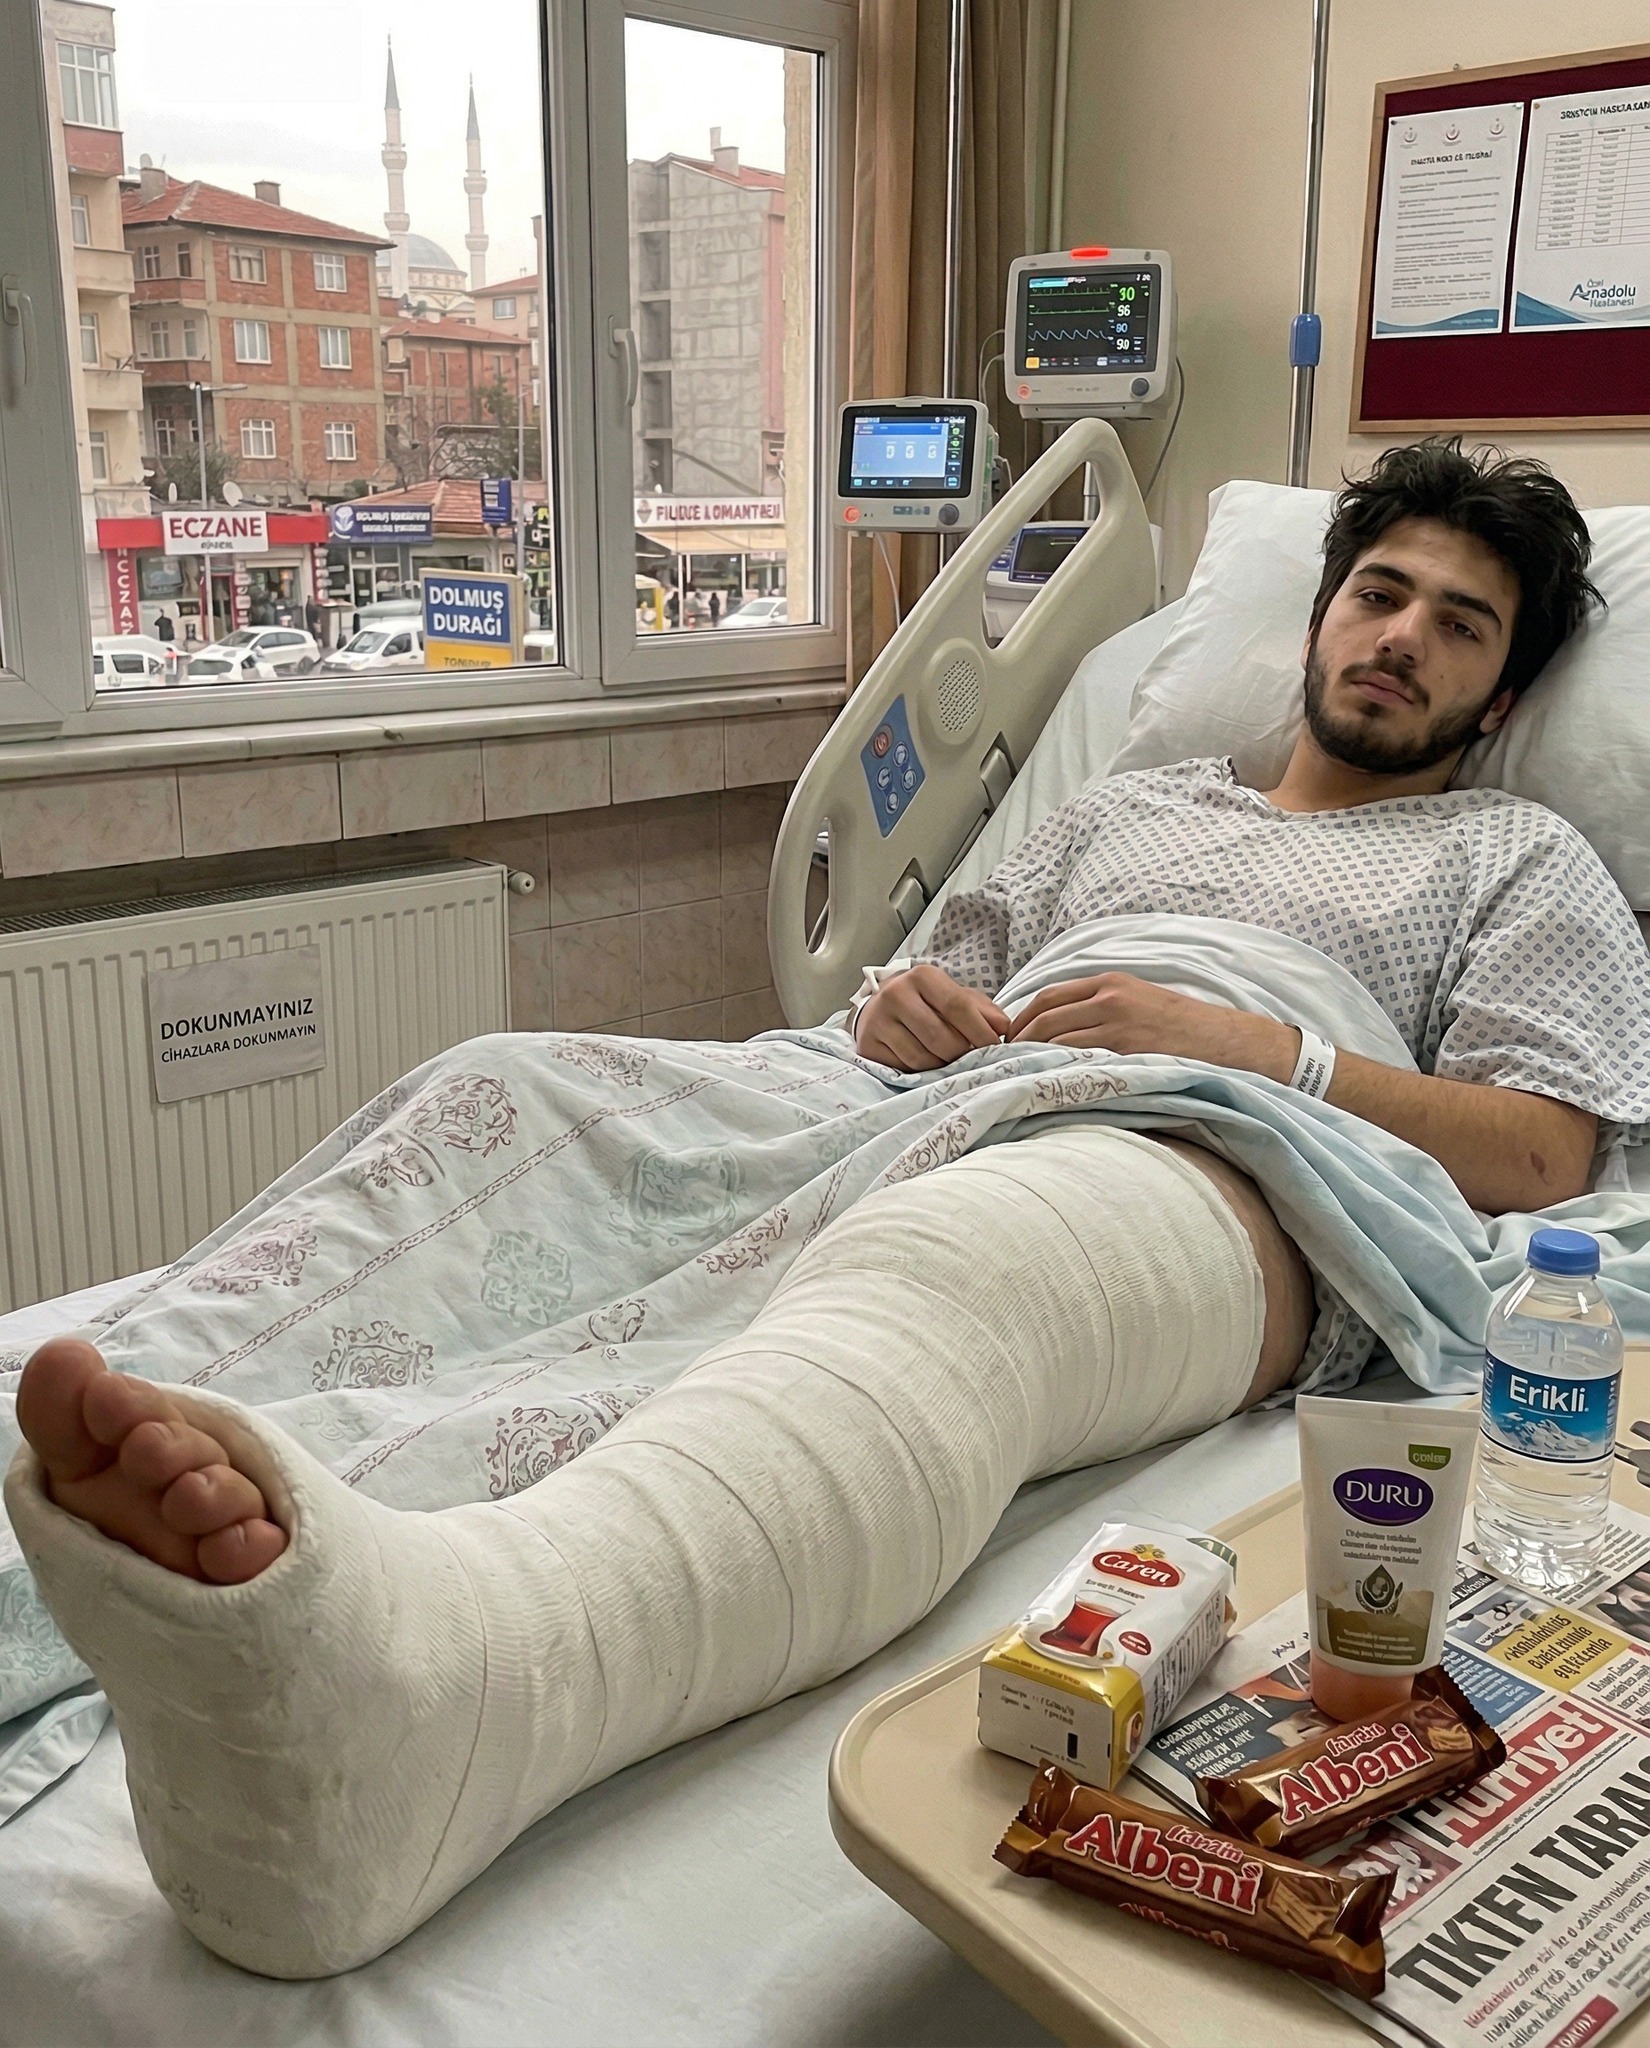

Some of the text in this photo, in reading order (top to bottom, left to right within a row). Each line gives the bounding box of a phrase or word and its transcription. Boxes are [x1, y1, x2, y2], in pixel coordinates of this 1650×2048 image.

[1569, 284, 1636, 301] Anadolu
[169, 516, 263, 539] ECZANE
[429, 586, 504, 615] DOLMUŞ
[433, 612, 502, 636] DURAĞI
[160, 998, 314, 1040] DOKUNMAYINIZ
[233, 1024, 316, 1050] DOKUNMAYIN
[1509, 1374, 1587, 1412] Erikli
[1343, 1480, 1423, 1508] DURU
[1280, 1723, 1434, 1826] Albeni
[1063, 1814, 1264, 1916] Albeni
